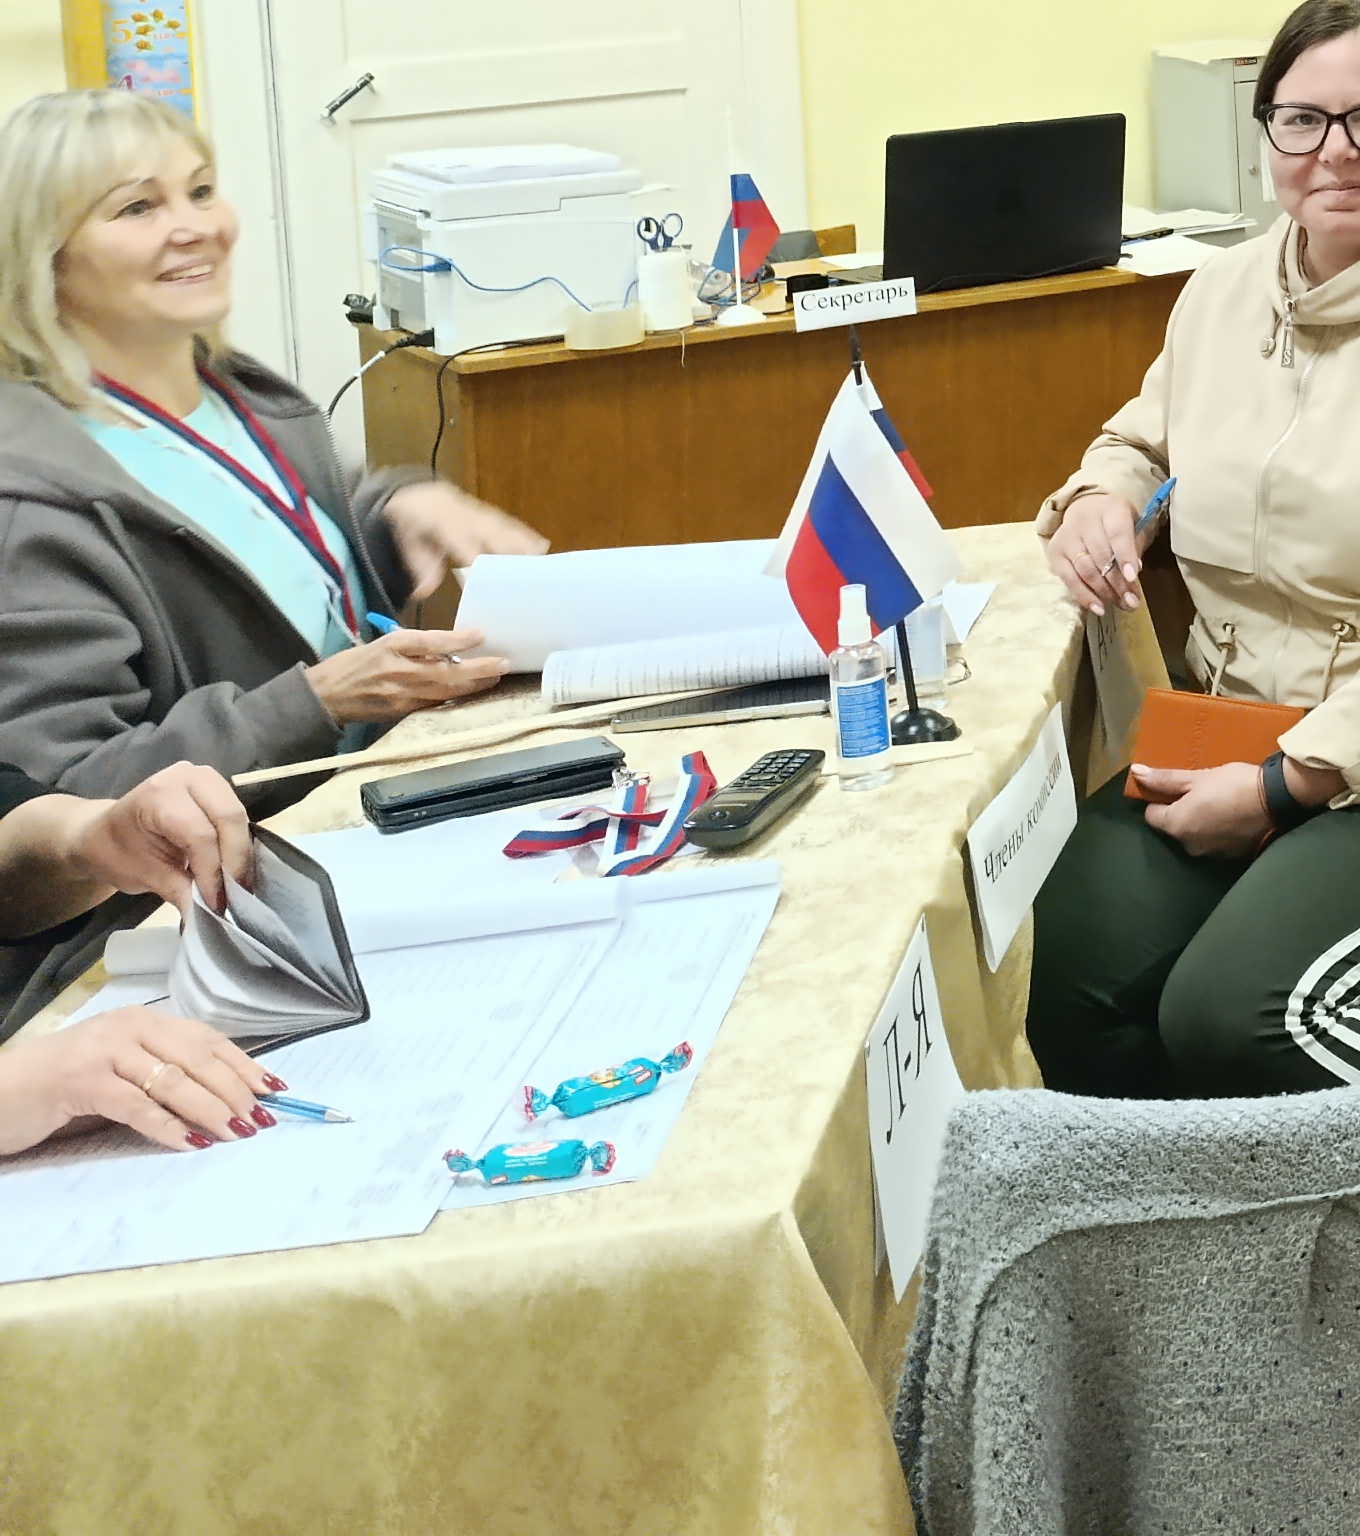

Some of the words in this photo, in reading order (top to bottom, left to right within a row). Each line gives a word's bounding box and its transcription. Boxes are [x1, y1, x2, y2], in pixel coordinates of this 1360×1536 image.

[111, 19, 133, 44] 5
[800, 284, 908, 312] Секретарь
[983, 821, 1024, 884] Члены
[1027, 751, 1062, 834] комиссии
[882, 956, 933, 1145] Л-Я
